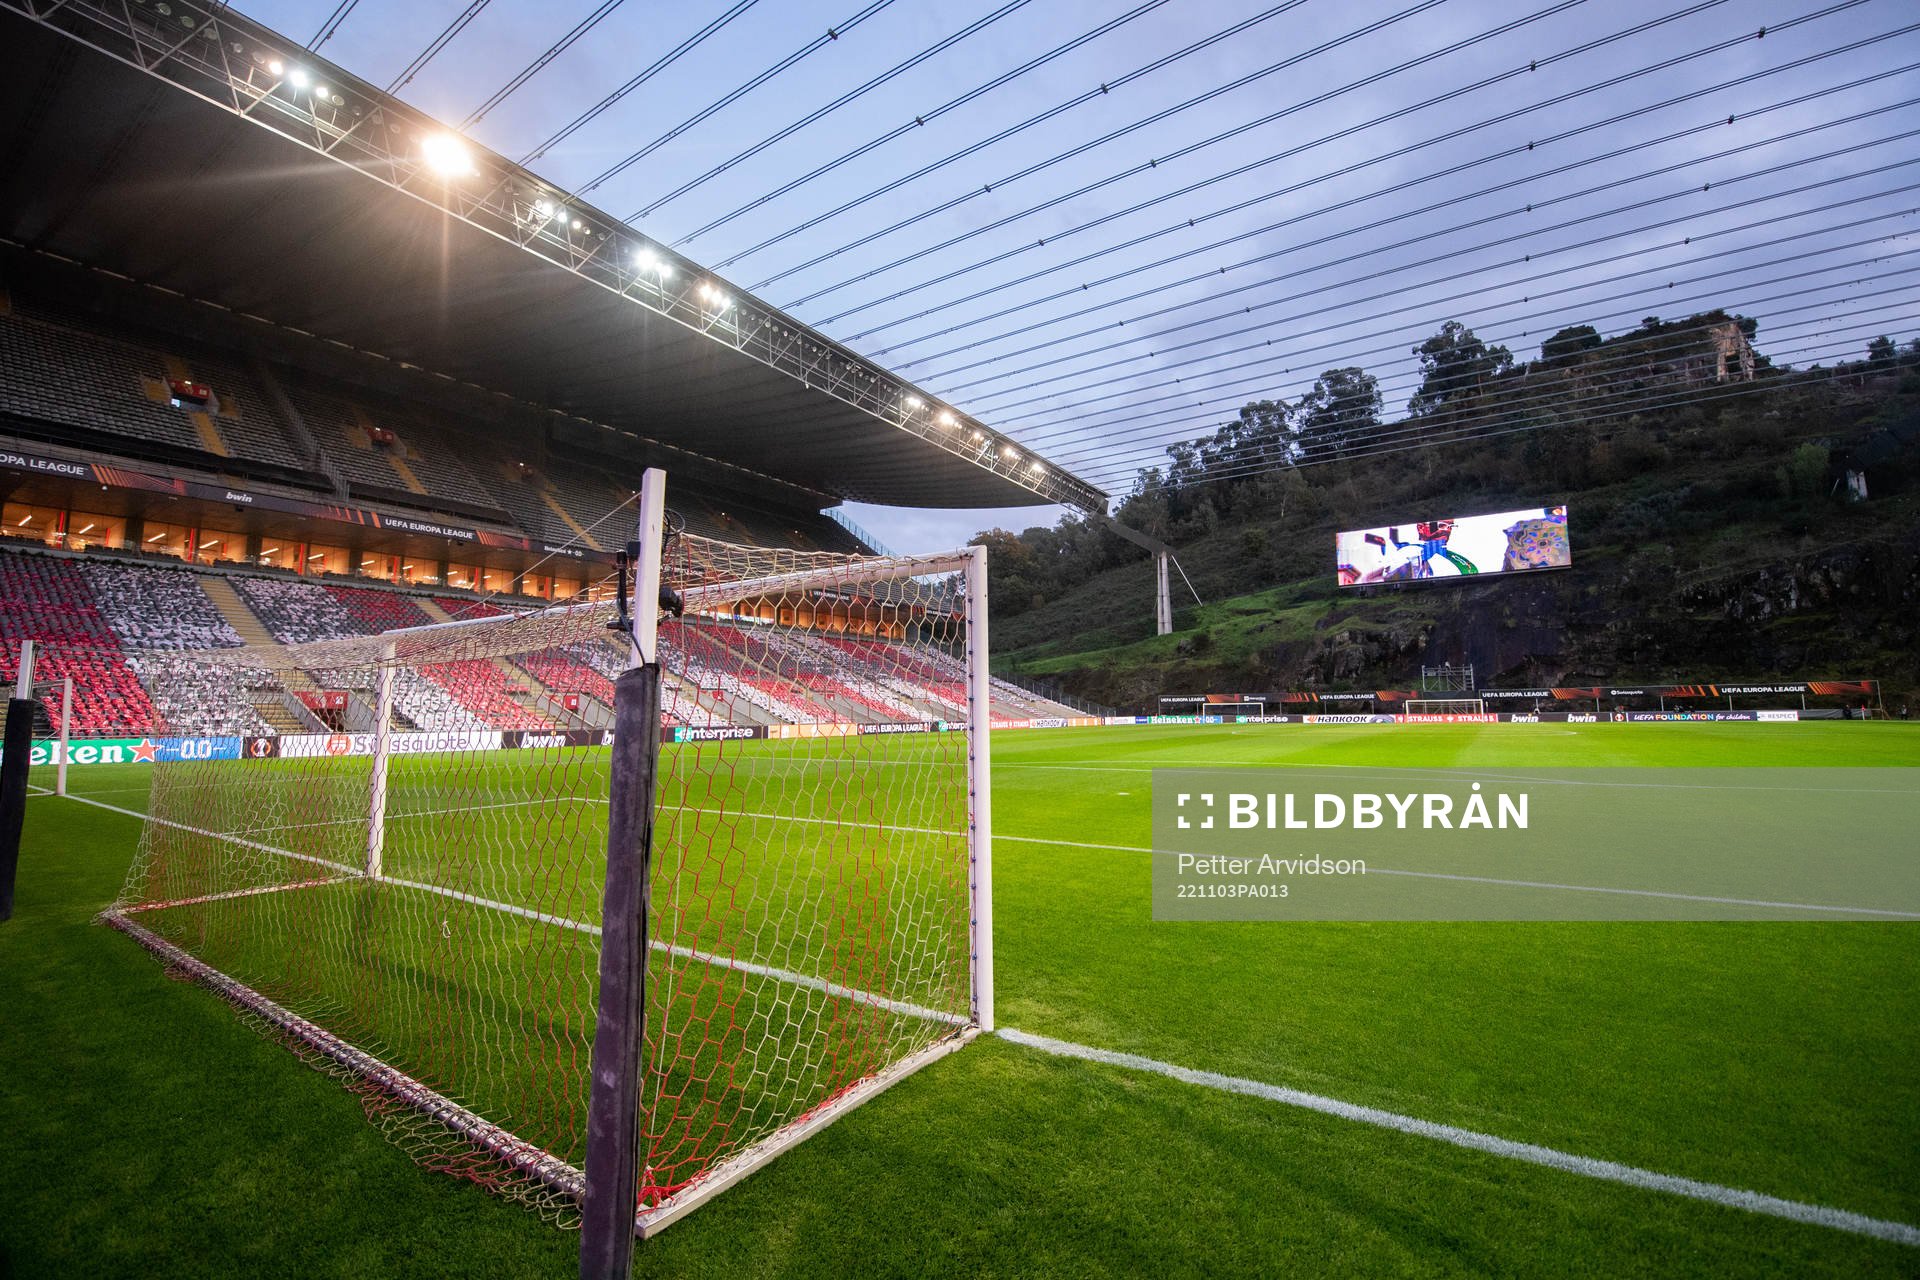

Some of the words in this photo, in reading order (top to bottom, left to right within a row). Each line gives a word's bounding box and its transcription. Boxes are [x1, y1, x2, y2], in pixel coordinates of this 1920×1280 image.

[29, 459, 84, 475] LEAGUE
[225, 491, 253, 503] bwin
[385, 518, 408, 529] UEFA
[409, 522, 441, 534] EUROPA
[442, 528, 473, 539] LEAGUE
[1151, 715, 1193, 724] Heineken
[1511, 713, 1539, 723] bwin
[1567, 713, 1597, 723] bwin
[1715, 713, 1725, 722] for
[679, 726, 754, 741] enterprise
[520, 731, 567, 749] bwin
